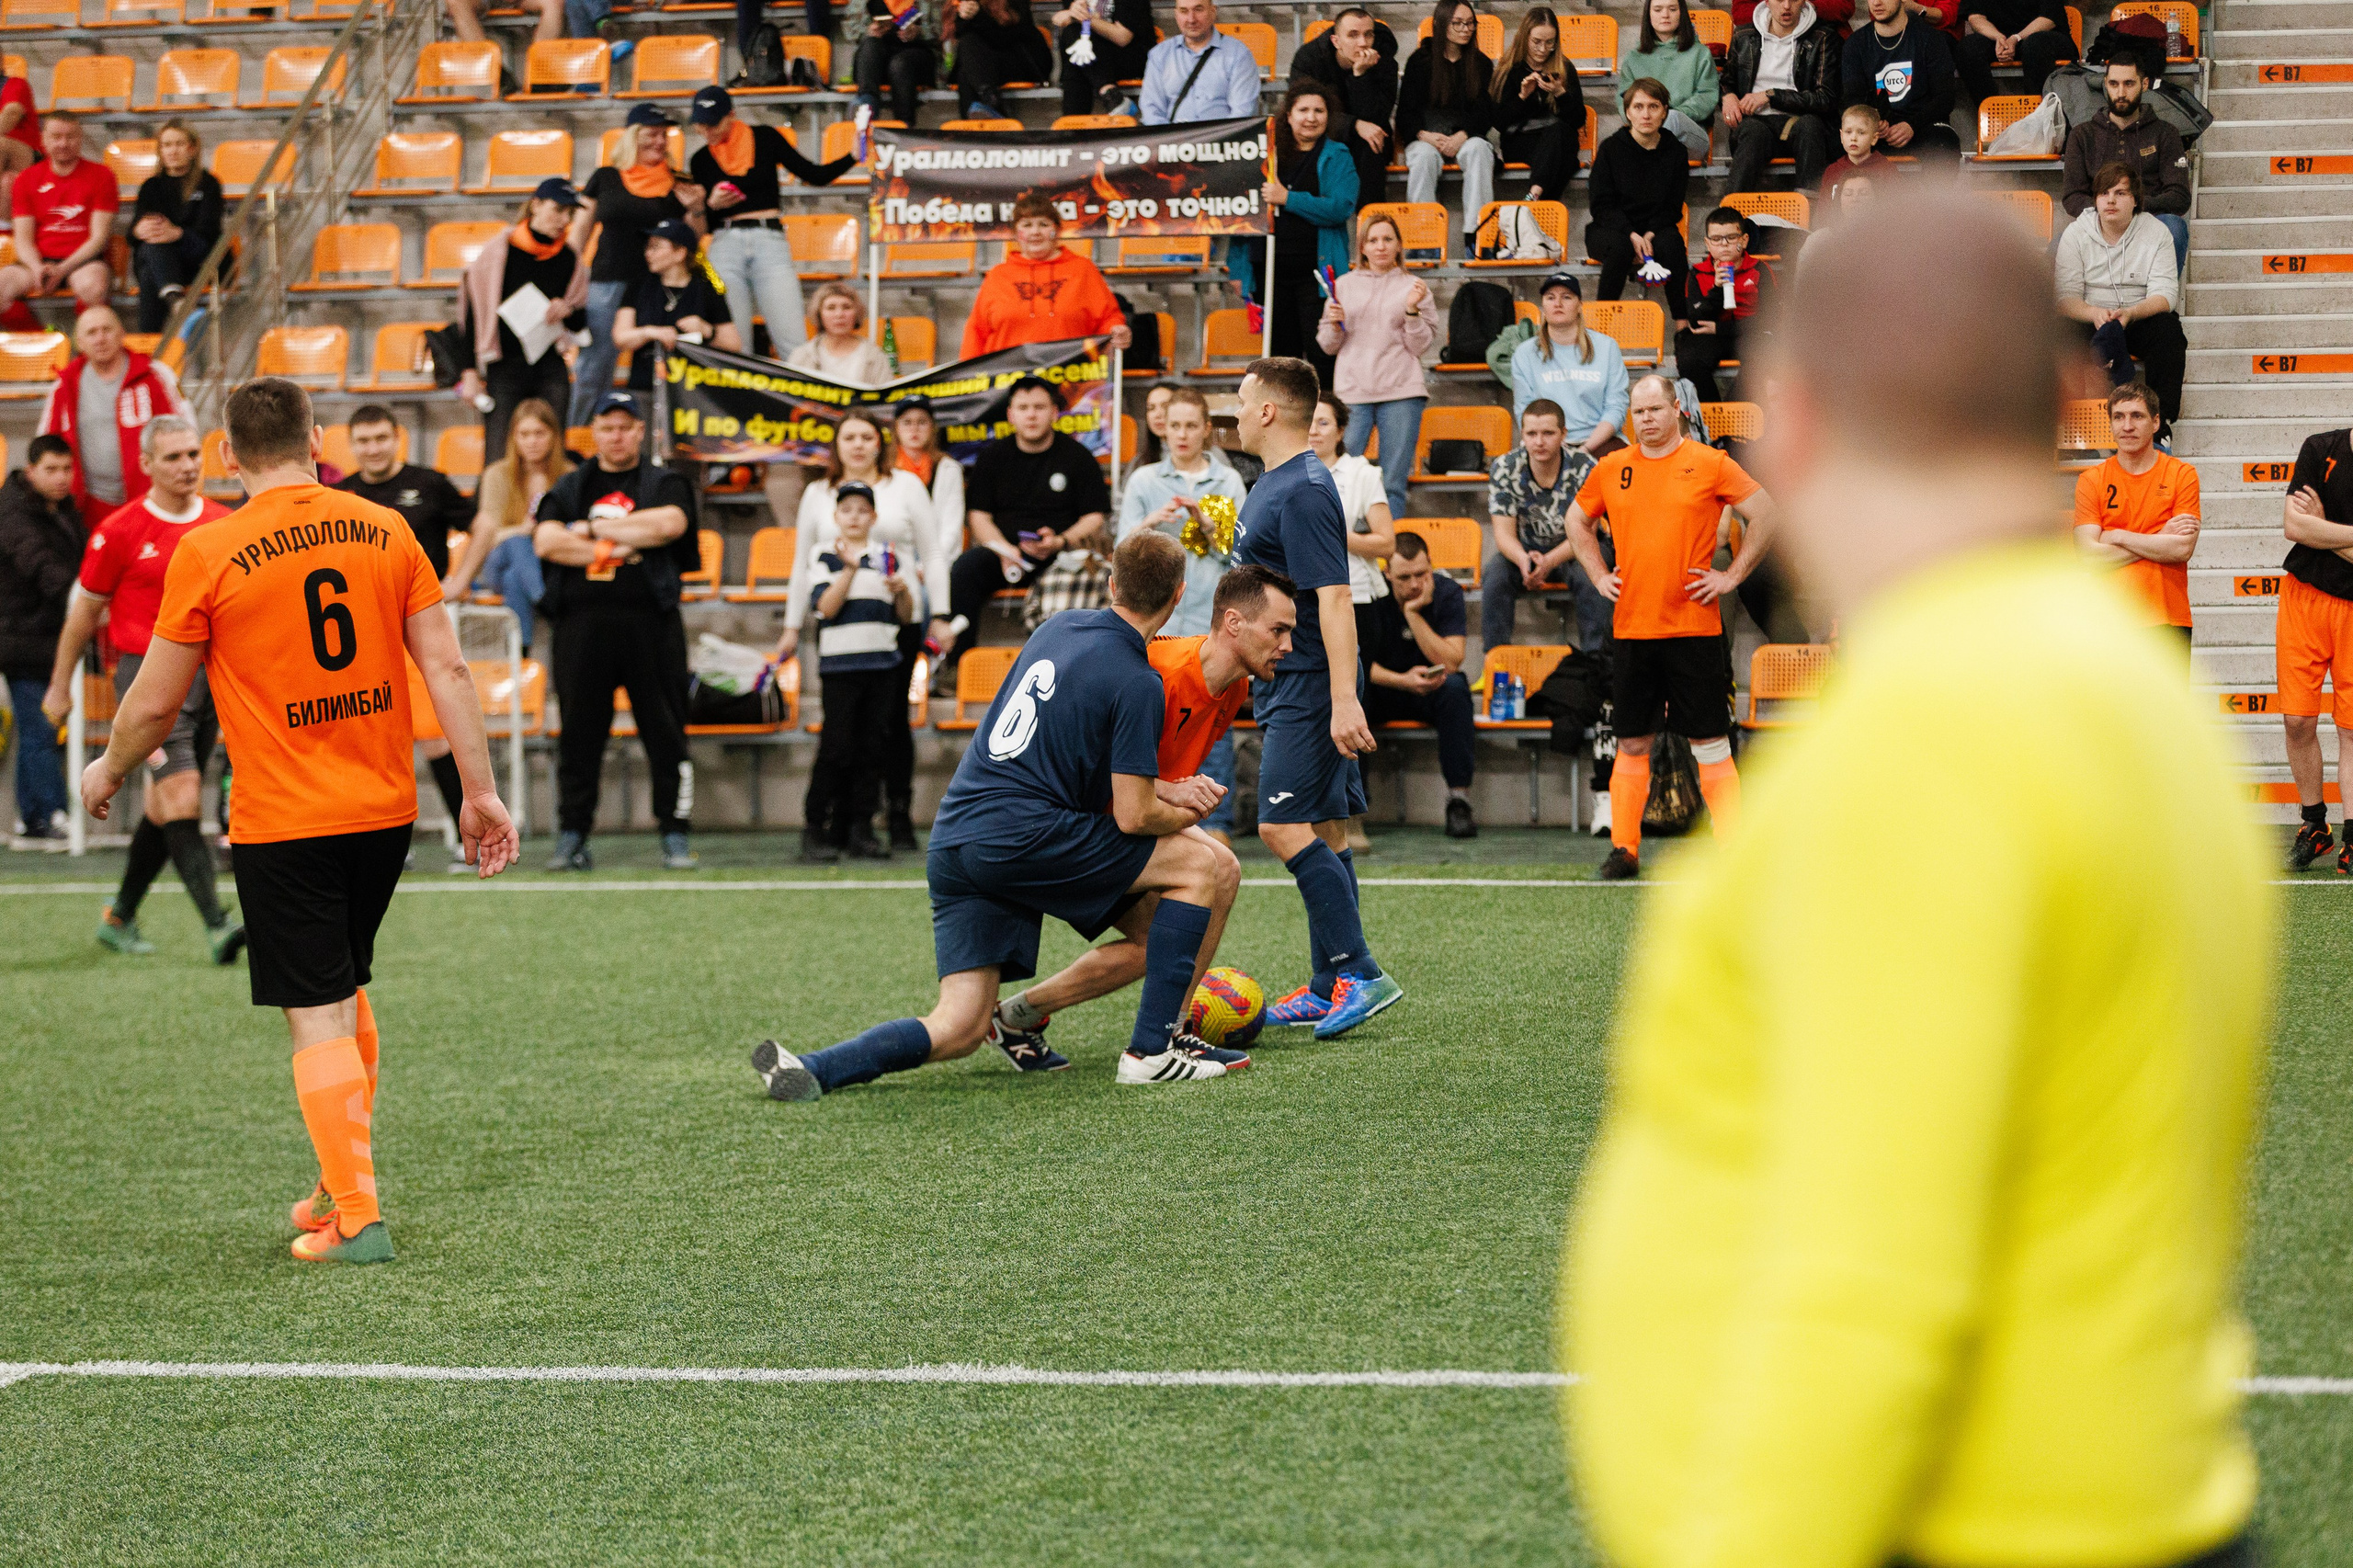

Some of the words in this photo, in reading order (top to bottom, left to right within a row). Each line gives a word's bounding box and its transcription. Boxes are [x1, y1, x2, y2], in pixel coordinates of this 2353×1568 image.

[2283, 66, 2301, 81] B7
[874, 143, 1074, 176] Уралдоломит
[1101, 145, 1151, 165] это
[1157, 133, 1267, 163] мощно!
[2295, 157, 2313, 173] B7
[885, 196, 993, 224] Победа
[999, 201, 1077, 222] на
[1107, 198, 1158, 220] это
[1165, 188, 1259, 219] точно!
[2289, 256, 2306, 272] B7
[2279, 356, 2298, 372] B7
[674, 408, 699, 436] И
[703, 415, 740, 437] по
[745, 413, 835, 445] футбо
[1620, 466, 1633, 490] 9
[2270, 464, 2289, 481] B7
[2107, 483, 2119, 509] 2
[230, 518, 392, 576] УРАЛДОЛОМИТ
[304, 567, 358, 672] 6
[286, 679, 393, 729] БИЛИМБАЙ
[988, 659, 1056, 762] 6
[2248, 694, 2268, 711] B7
[1174, 708, 1192, 742] 7
